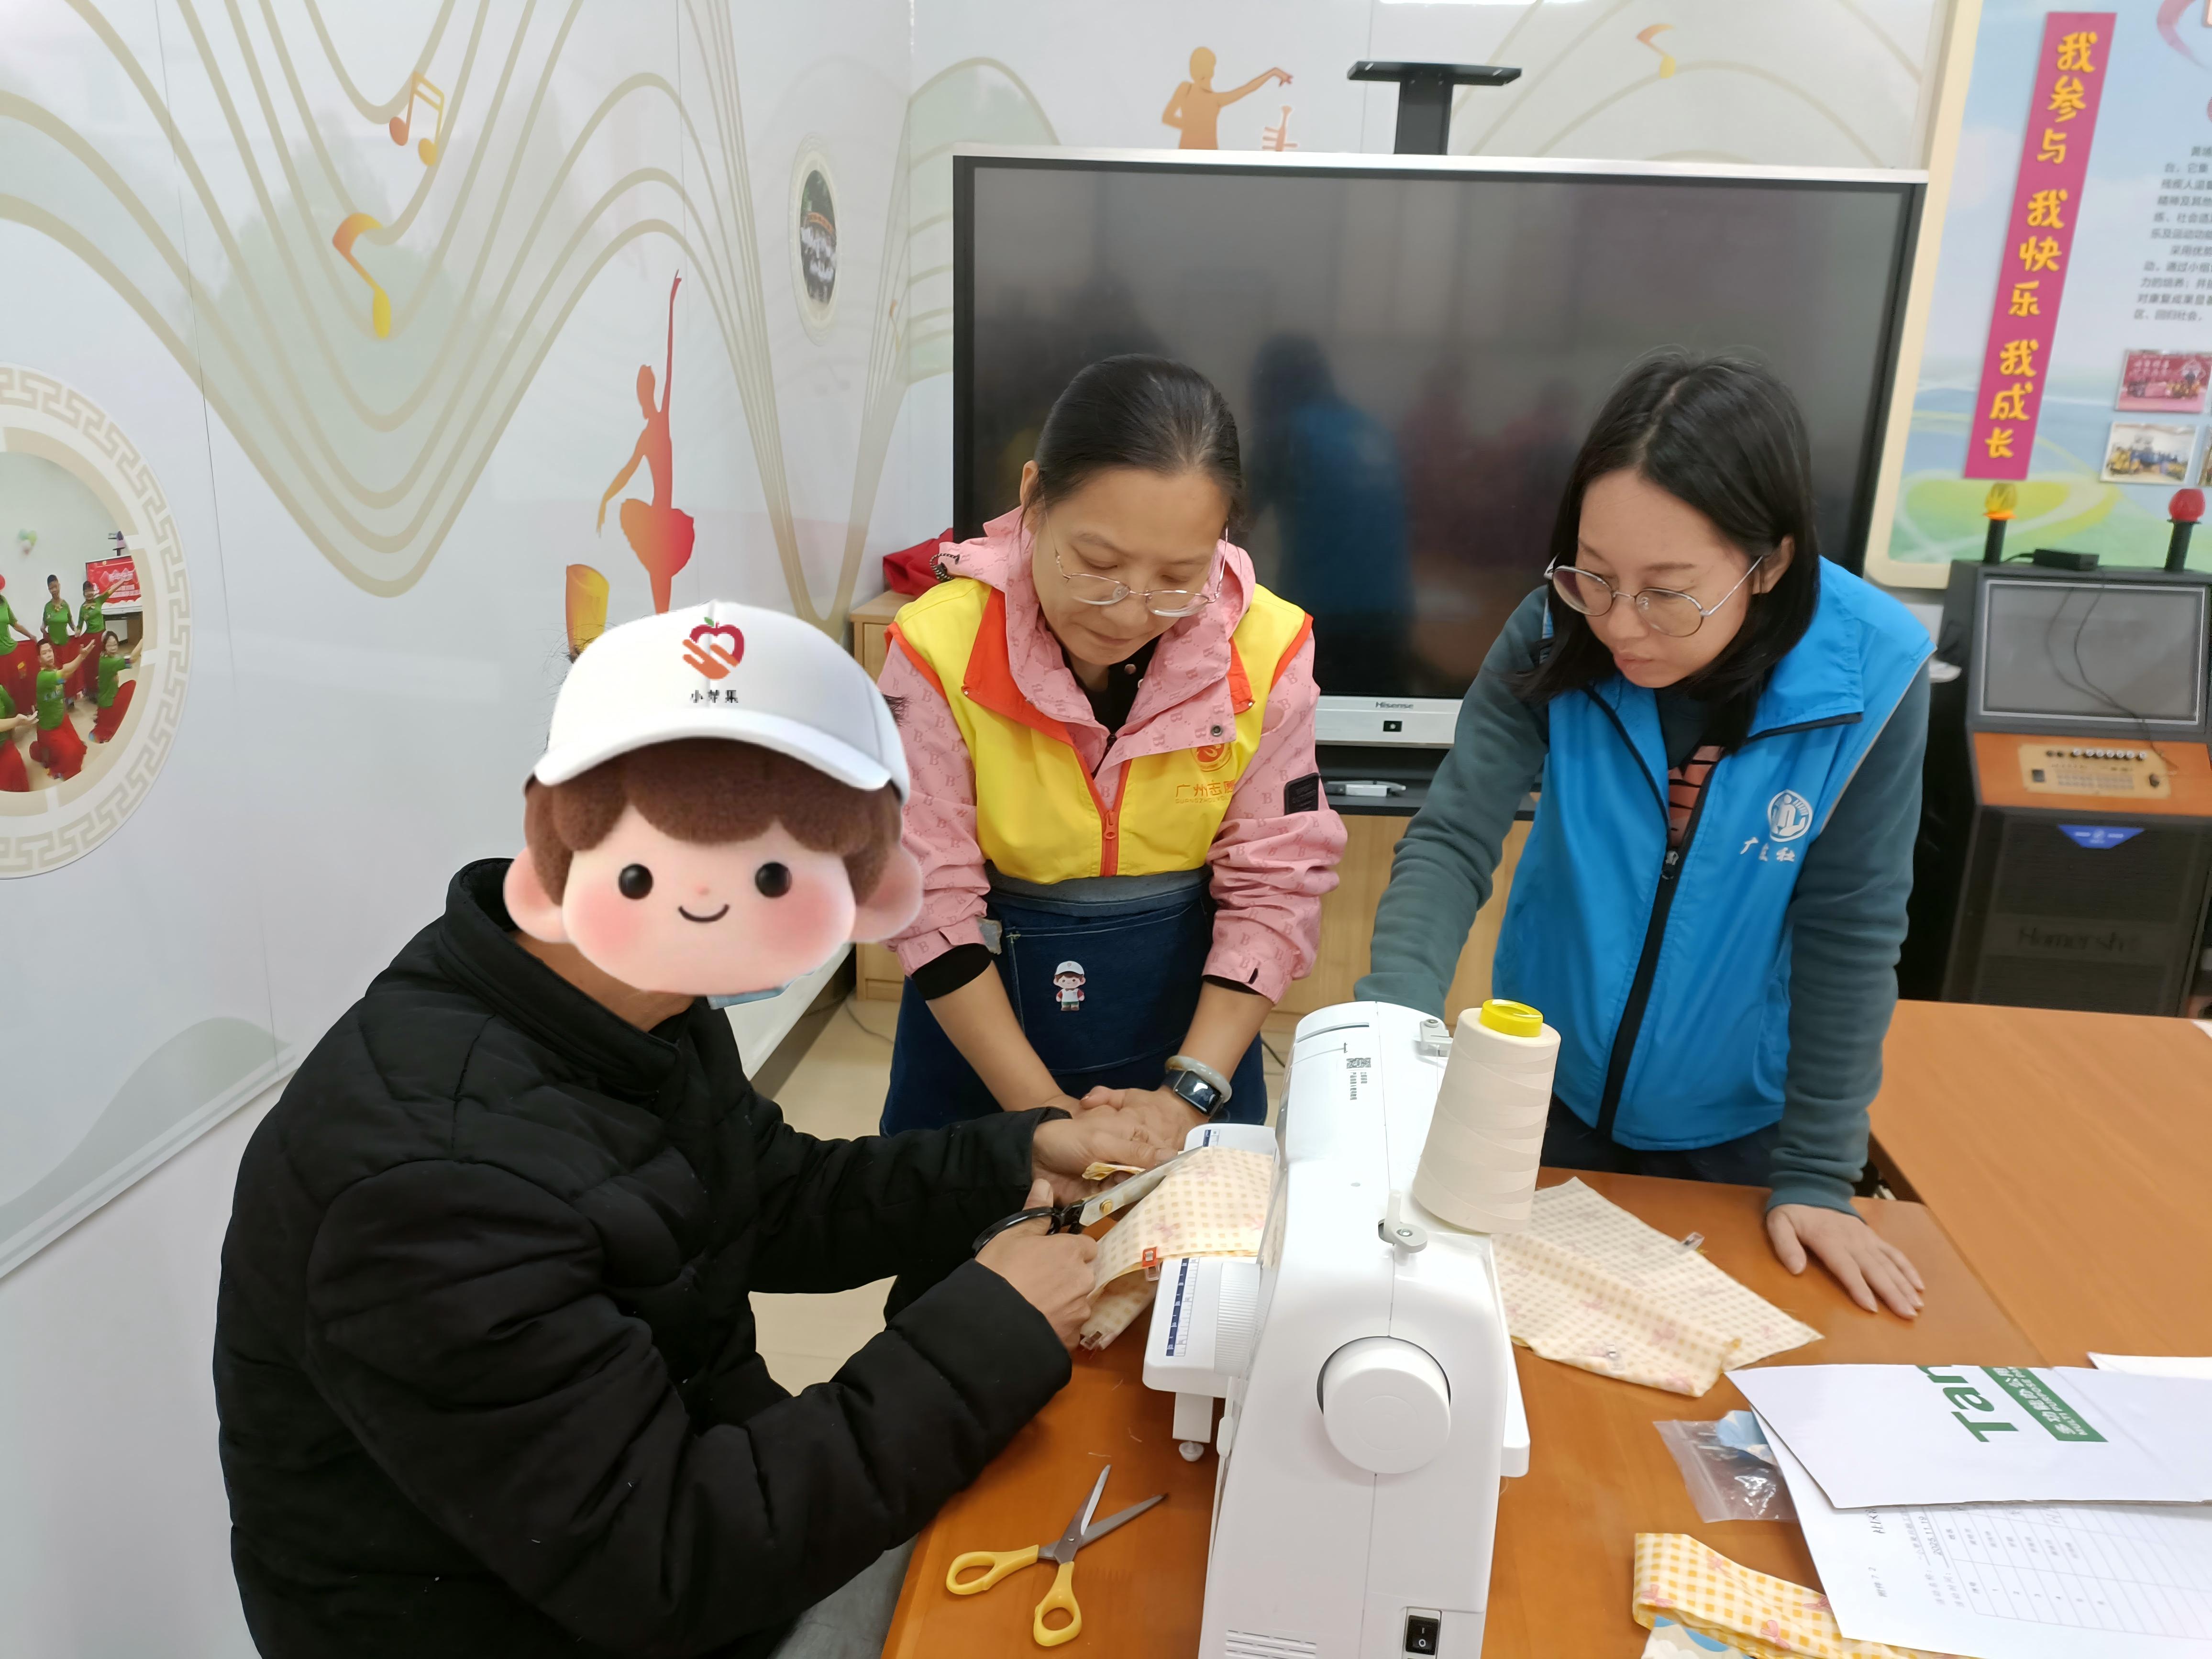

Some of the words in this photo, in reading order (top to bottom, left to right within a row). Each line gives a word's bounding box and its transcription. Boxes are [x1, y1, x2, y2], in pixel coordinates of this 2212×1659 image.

[2036, 32, 2098, 164] 我参与
[2008, 188, 2068, 317] 我快乐
[1984, 339, 2039, 459] 我成长
